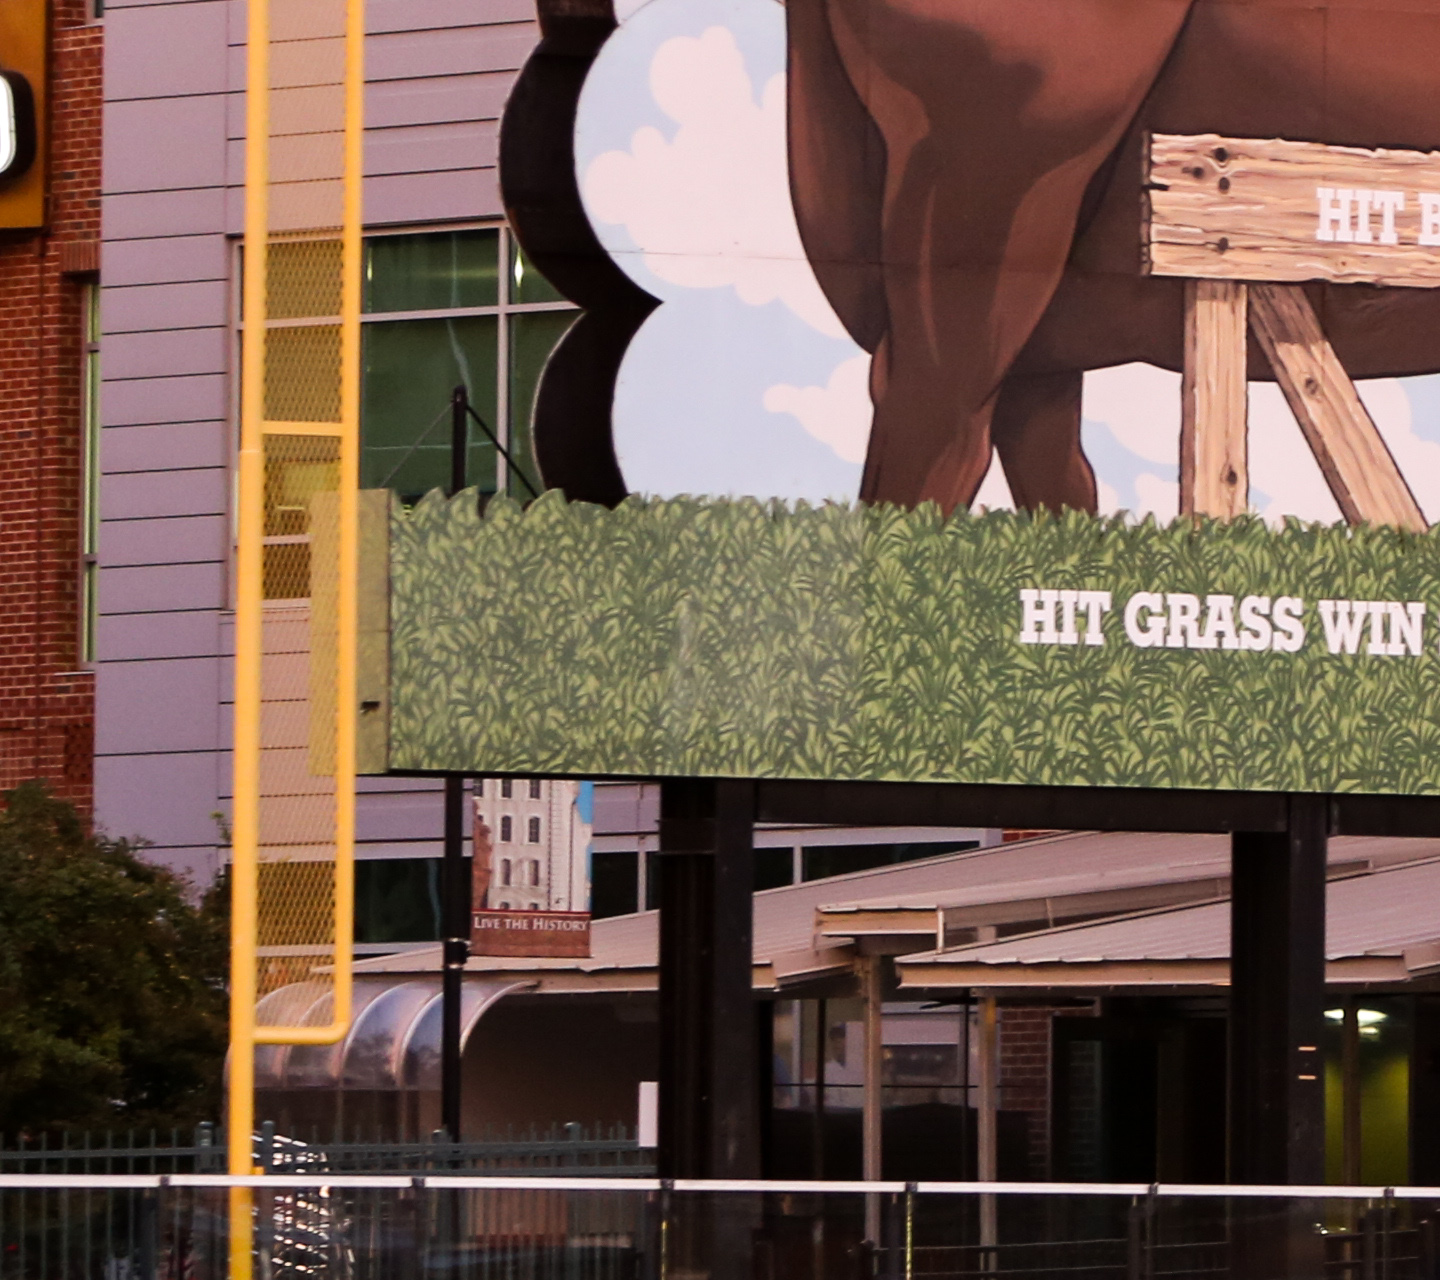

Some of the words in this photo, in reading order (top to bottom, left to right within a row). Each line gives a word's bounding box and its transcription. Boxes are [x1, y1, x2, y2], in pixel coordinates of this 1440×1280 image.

[1315, 187, 1405, 245] HIT
[1020, 589, 1111, 645] HIT
[1124, 591, 1305, 652] GRASS
[1318, 600, 1425, 656] WIN
[474, 916, 500, 930] LIVE
[504, 917, 529, 931] THE
[532, 917, 588, 932] HISTORY
